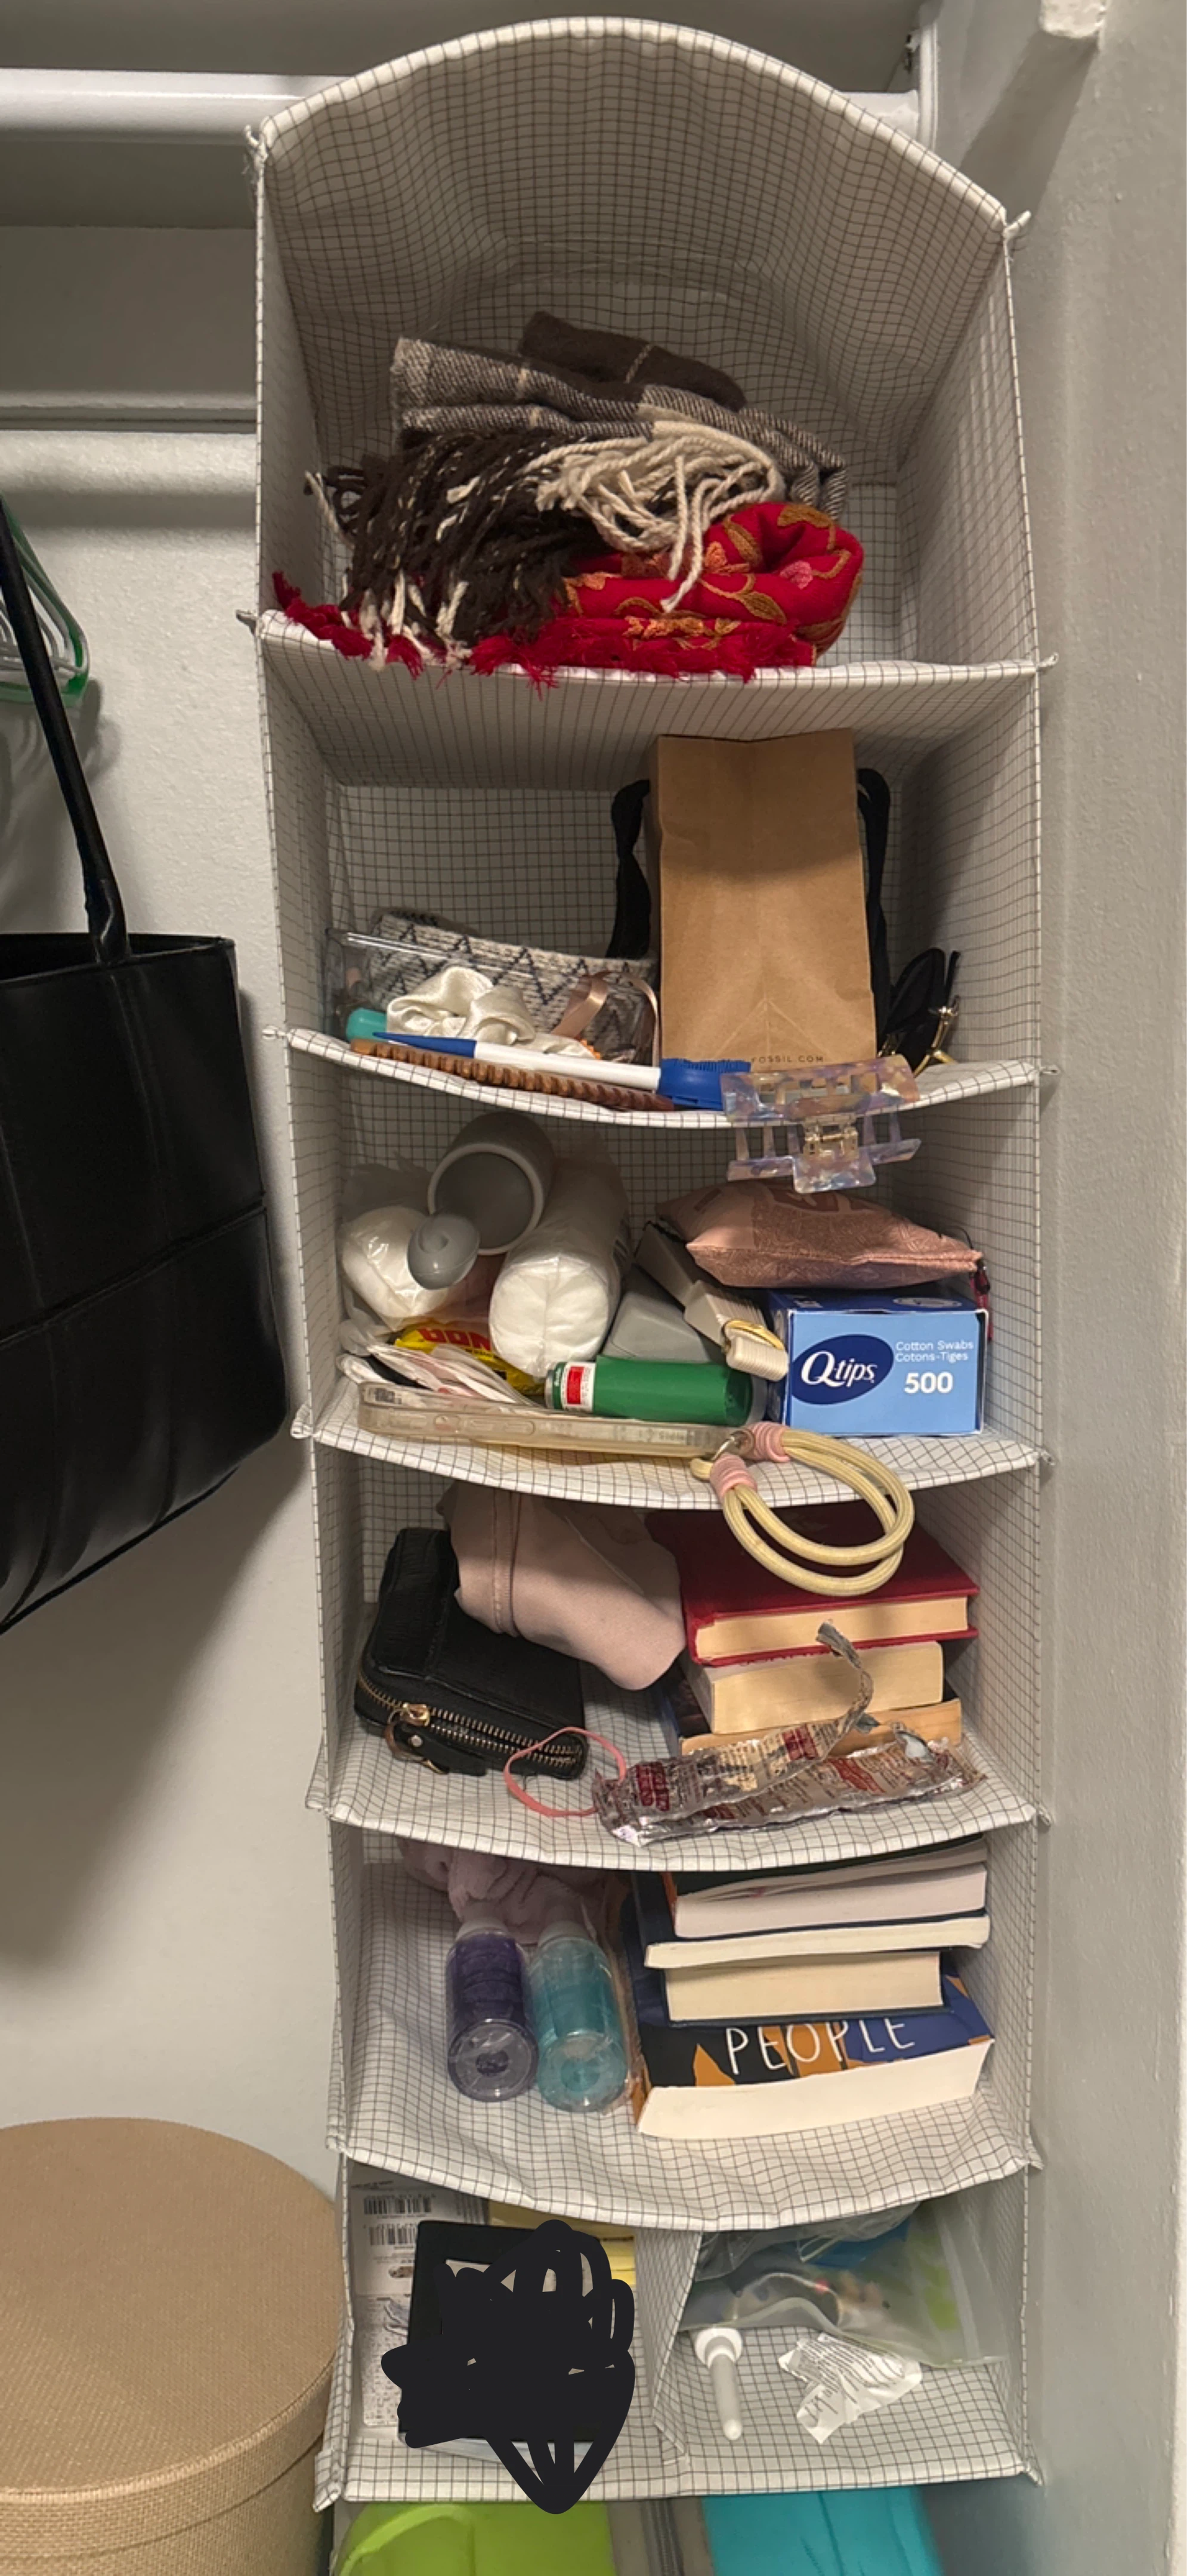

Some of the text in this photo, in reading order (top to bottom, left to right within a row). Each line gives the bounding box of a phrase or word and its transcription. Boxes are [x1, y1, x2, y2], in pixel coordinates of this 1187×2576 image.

[896, 1340, 973, 1351] Cotton Swabs
[895, 1352, 969, 1363] Cotons-Tiges
[904, 1371, 953, 1394] 500
[725, 2018, 915, 2075] PEOPLE
